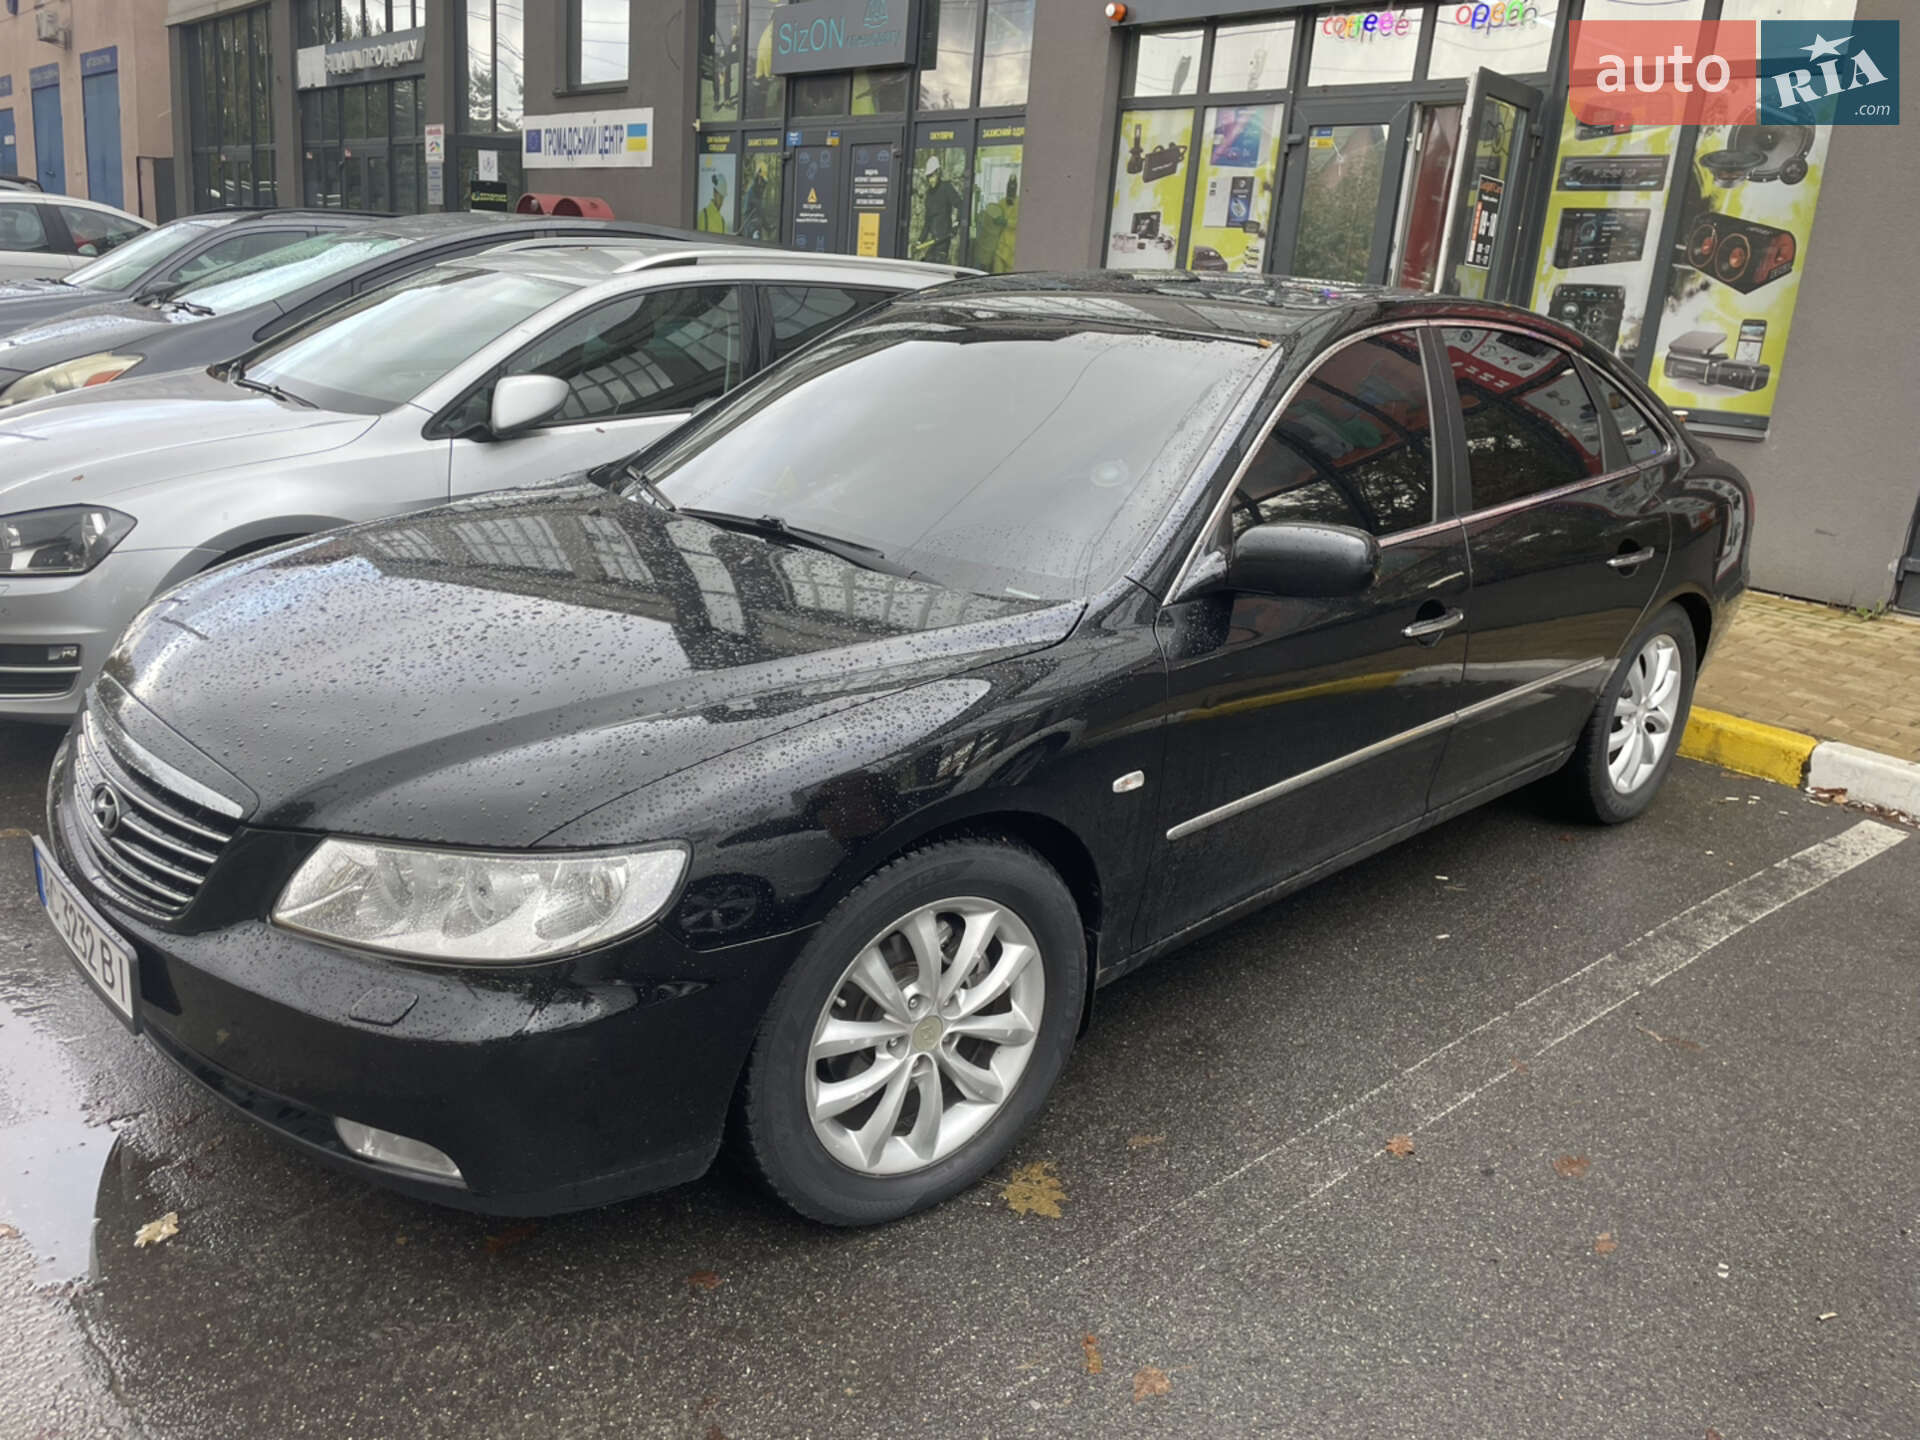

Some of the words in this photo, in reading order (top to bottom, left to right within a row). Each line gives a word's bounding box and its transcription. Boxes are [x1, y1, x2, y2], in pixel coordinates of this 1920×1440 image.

[361, 39, 418, 69] ПРОДАЖУ
[778, 15, 846, 55] SizON
[544, 118, 597, 162] ГРОМАДСЬКИЙ
[598, 124, 625, 161] ЦЕНТР
[100, 938, 126, 1003] BI
